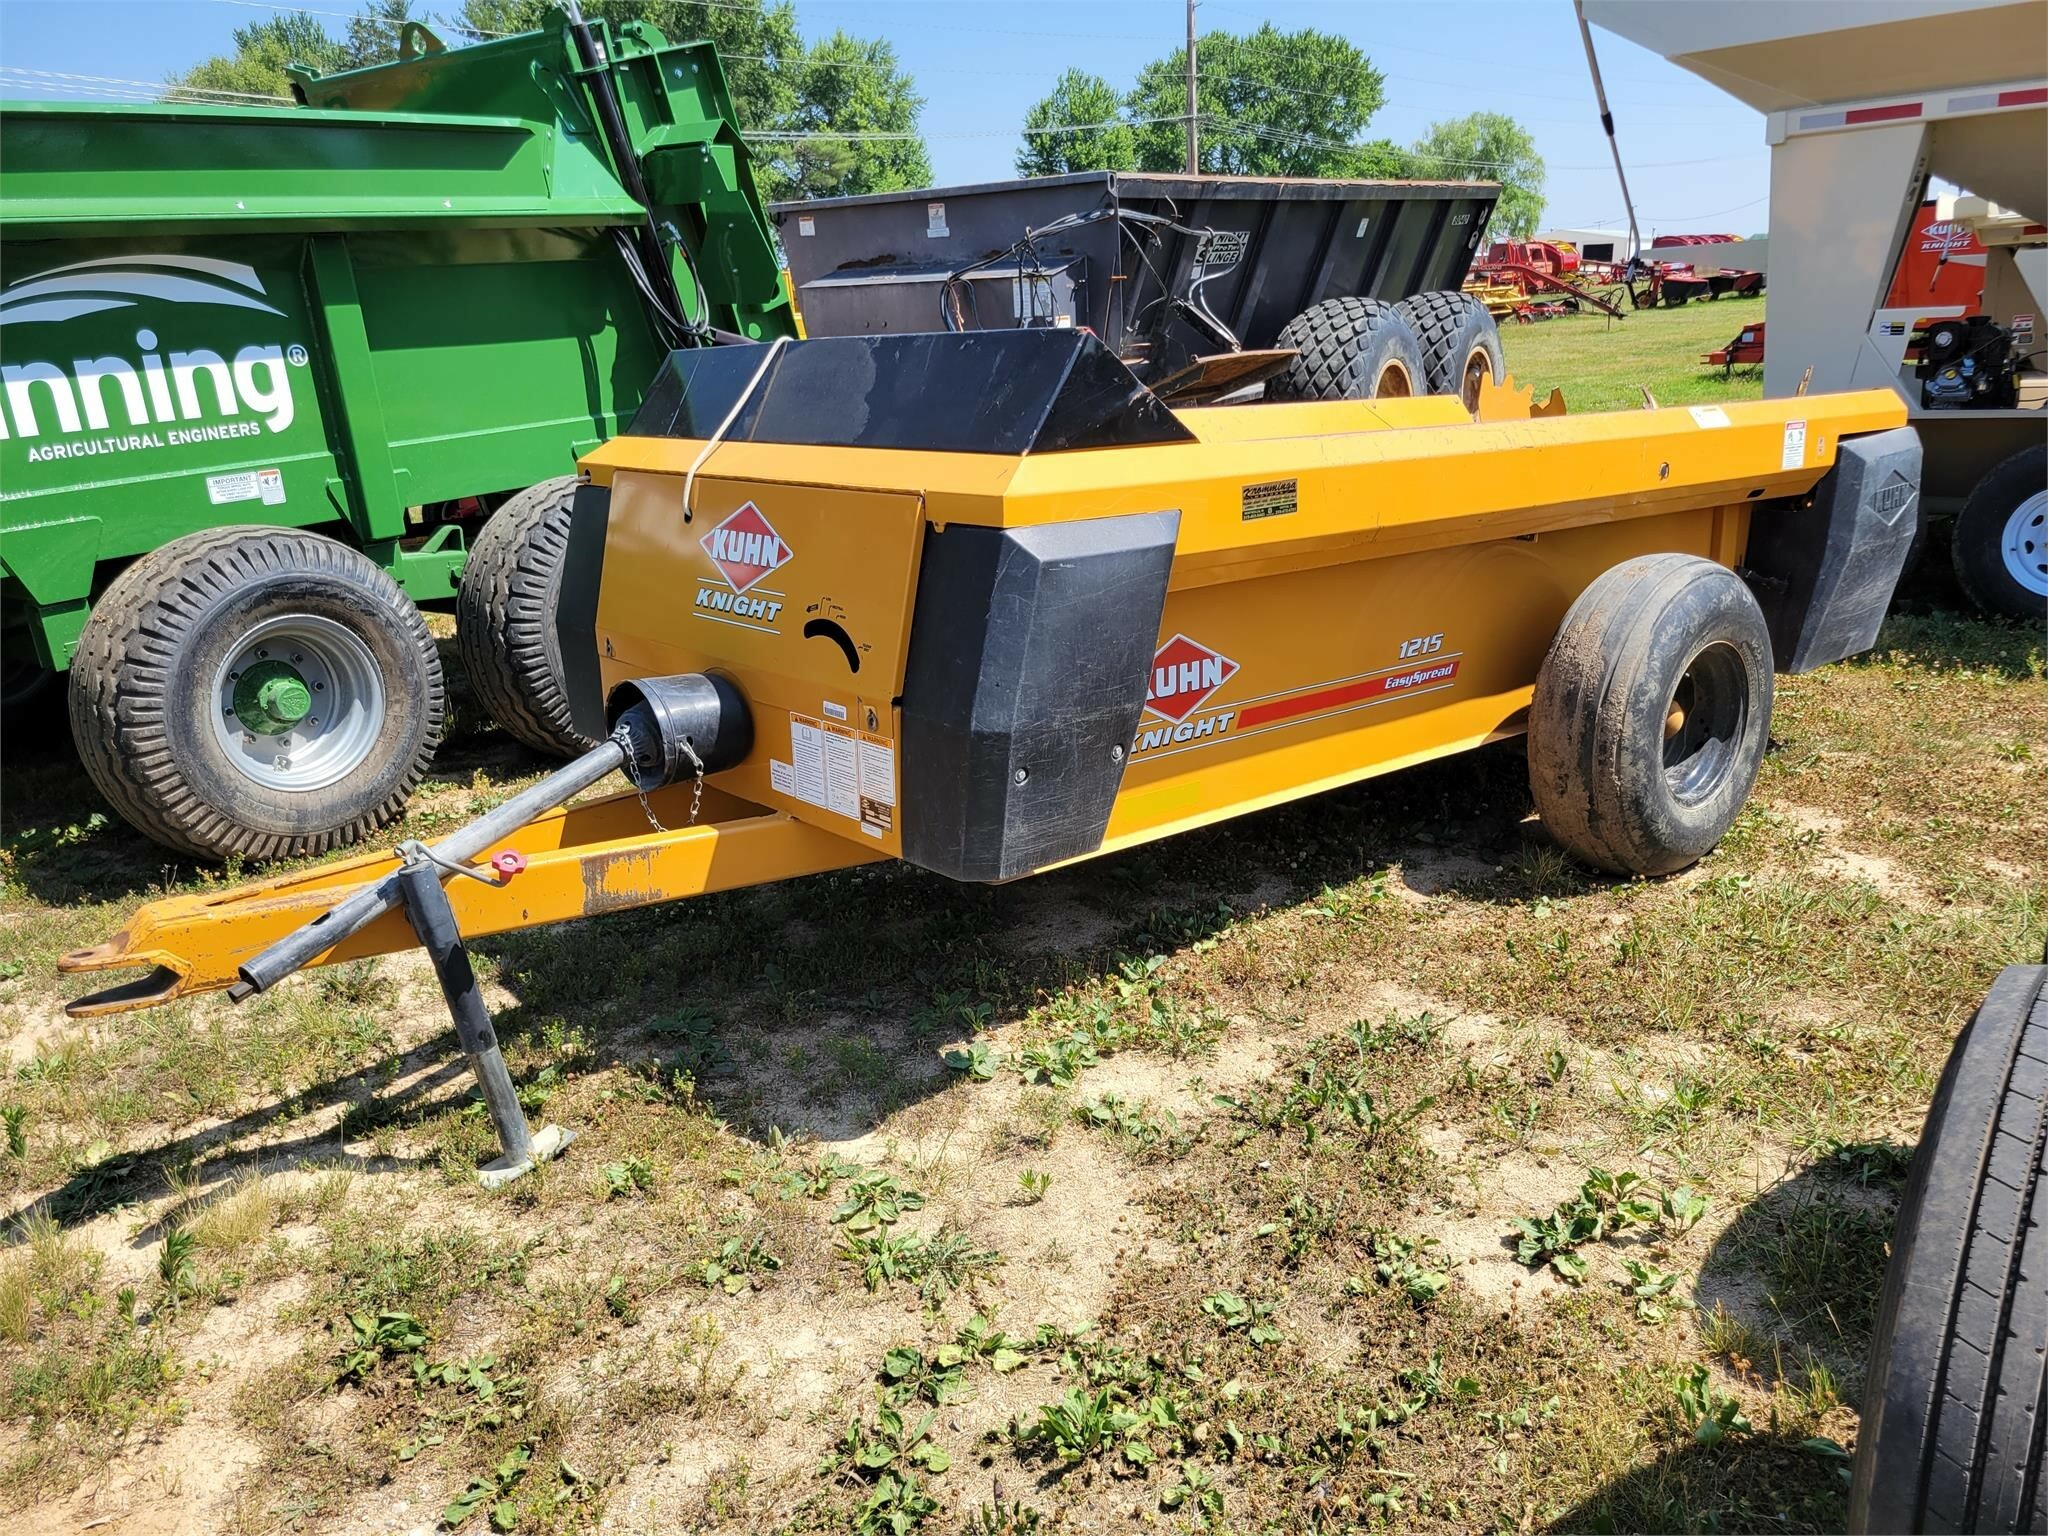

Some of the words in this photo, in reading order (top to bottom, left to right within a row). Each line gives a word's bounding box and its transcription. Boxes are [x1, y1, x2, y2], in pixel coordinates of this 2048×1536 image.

[28, 433, 165, 463] AGRICULTURAL
[168, 422, 261, 446] ENGINEERS
[212, 475, 252, 486] IMPORTANT
[710, 527, 780, 569] KUHN
[695, 588, 783, 622] KNIGHT
[1398, 632, 1445, 660] 1215
[1146, 656, 1223, 700] UHN
[1384, 663, 1454, 690] EasySpread
